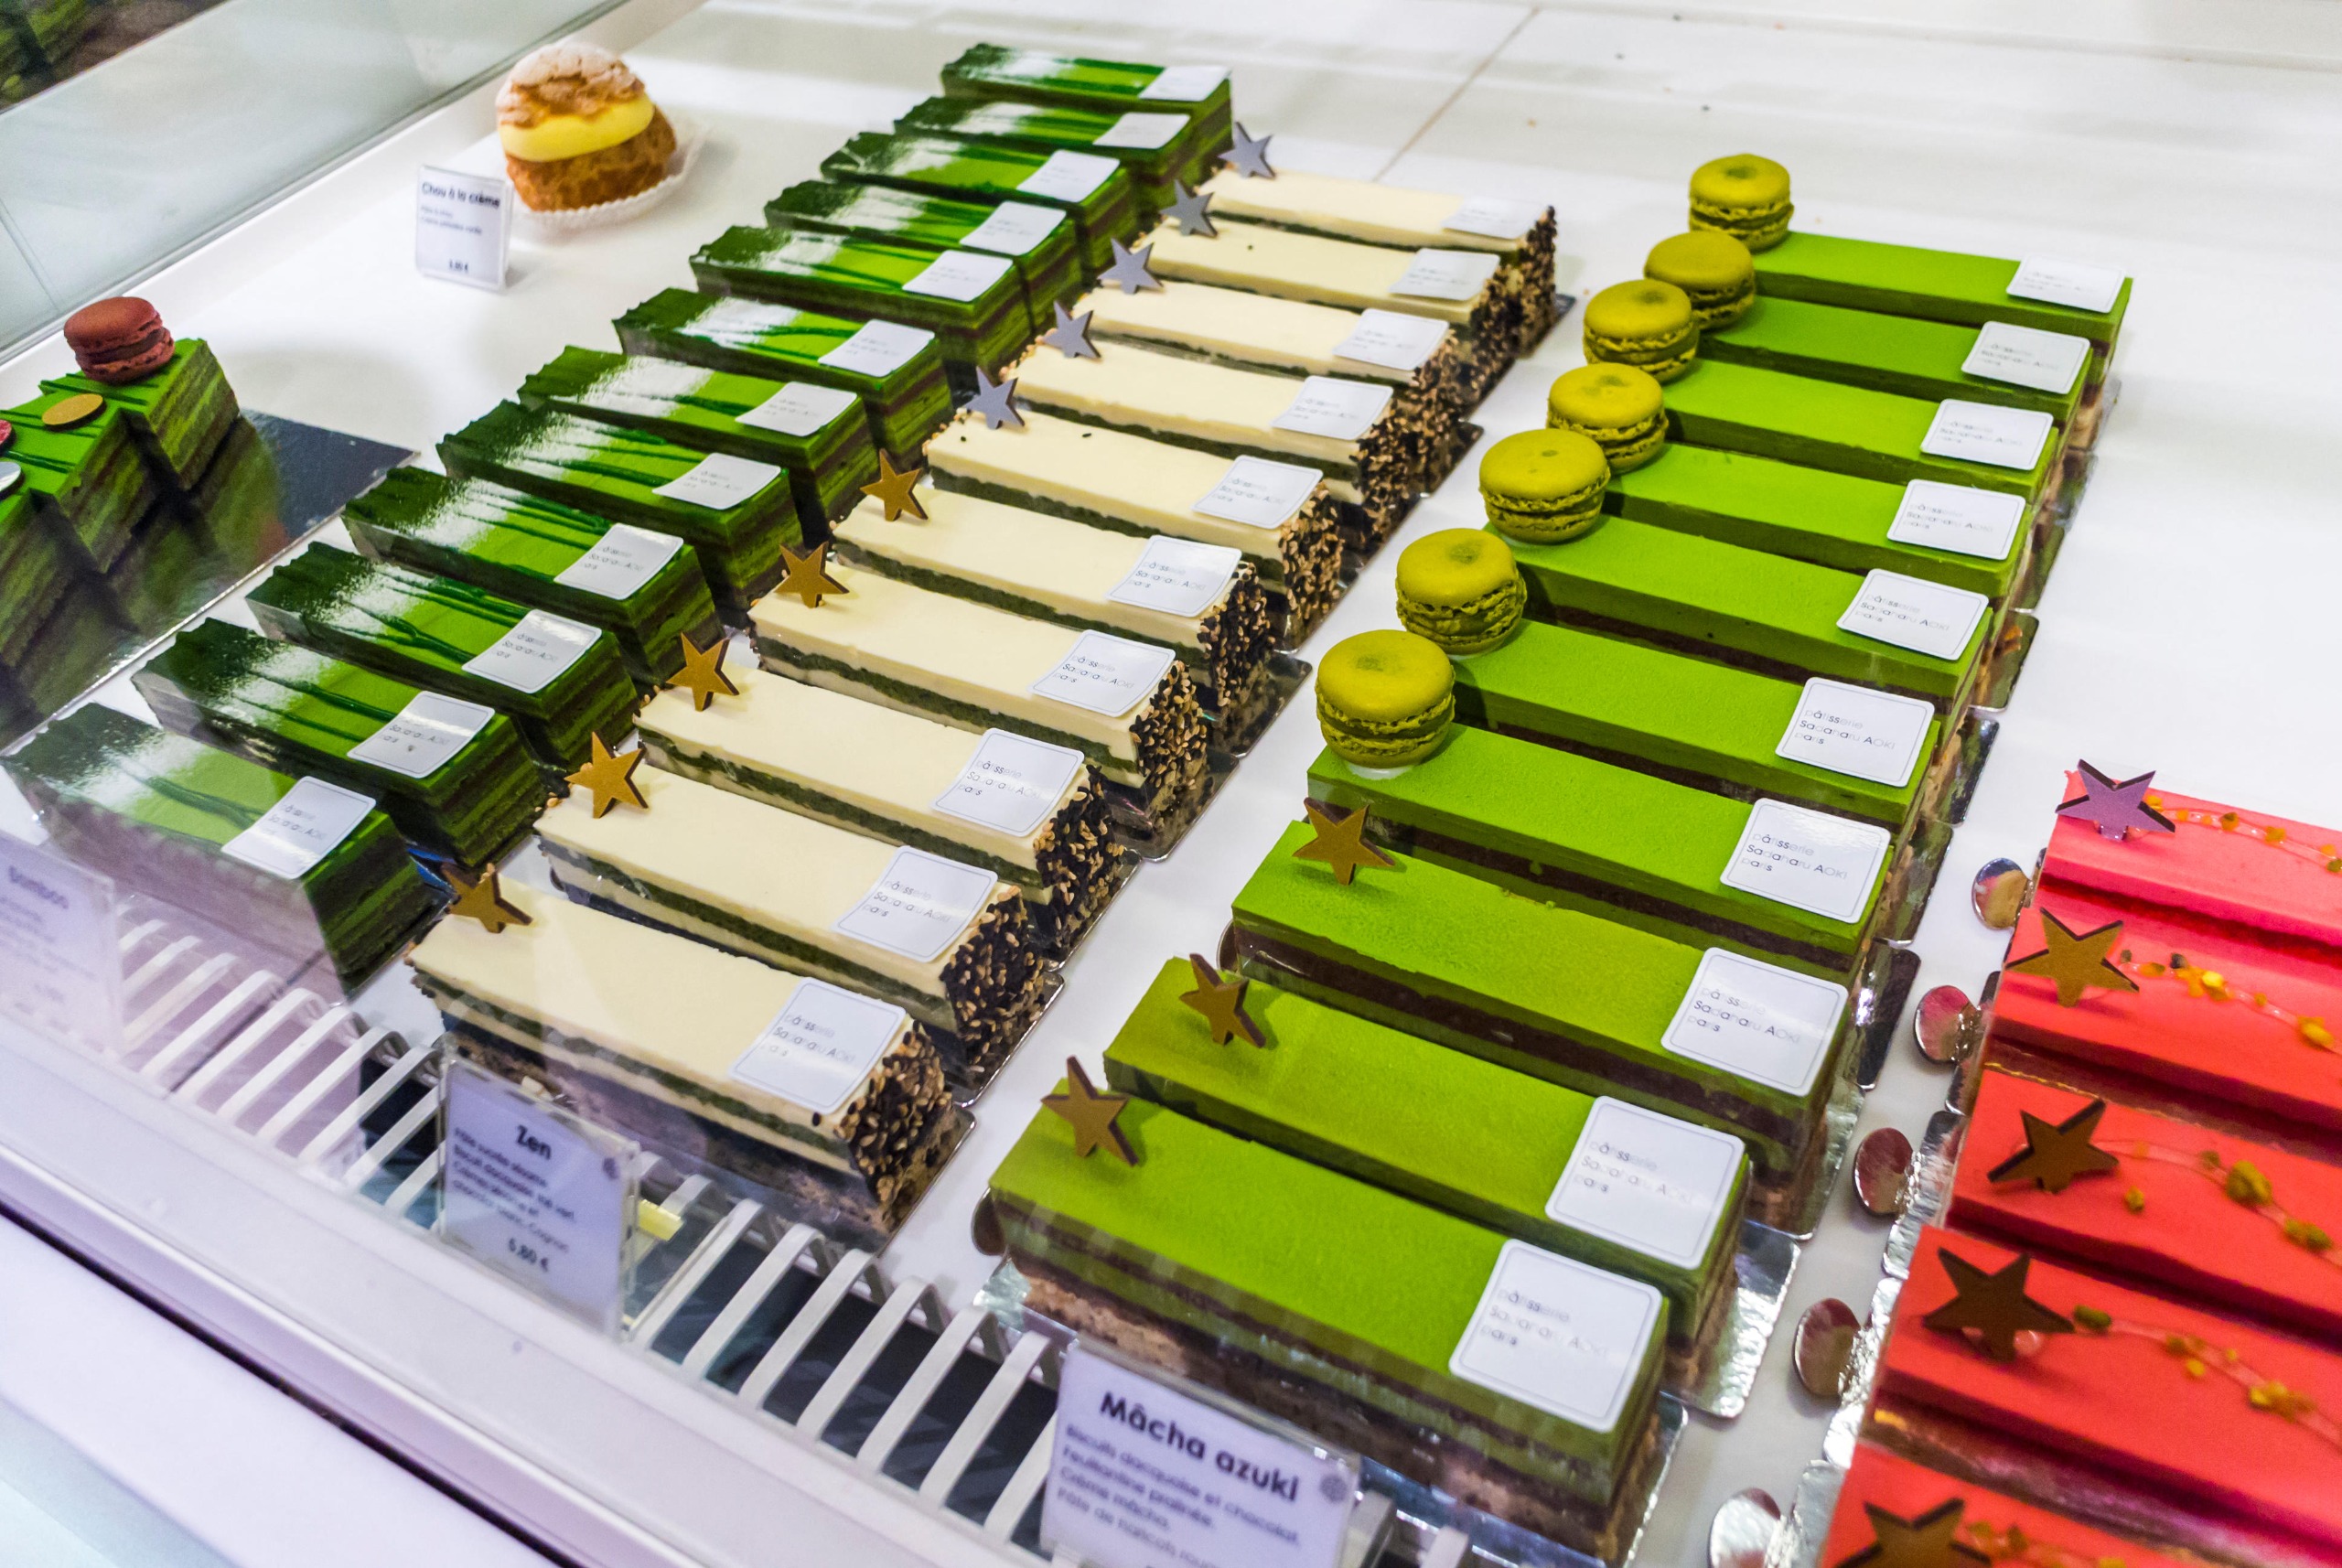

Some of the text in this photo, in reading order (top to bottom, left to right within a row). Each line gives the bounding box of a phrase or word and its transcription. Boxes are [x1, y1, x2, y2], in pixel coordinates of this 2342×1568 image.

[468, 190, 501, 209] crème
[1804, 709, 1864, 729] pâtisserie
[1794, 732, 1824, 745] paris
[1799, 720, 1896, 750] Sadaharu AOKI
[1753, 833, 1814, 856] pâtisserie
[1741, 858, 1772, 872] paris
[1746, 844, 1848, 879] Sadaharu AOKI
[1702, 988, 1766, 1015] pâtisserie
[1694, 1000, 1799, 1044] Sadaharu AOKI
[516, 1124, 552, 1160] Zen
[1582, 1155, 1653, 1189] Saaa
[1100, 1391, 1300, 1503] Mâcha azuki
[1204, 1490, 1221, 1507] et
